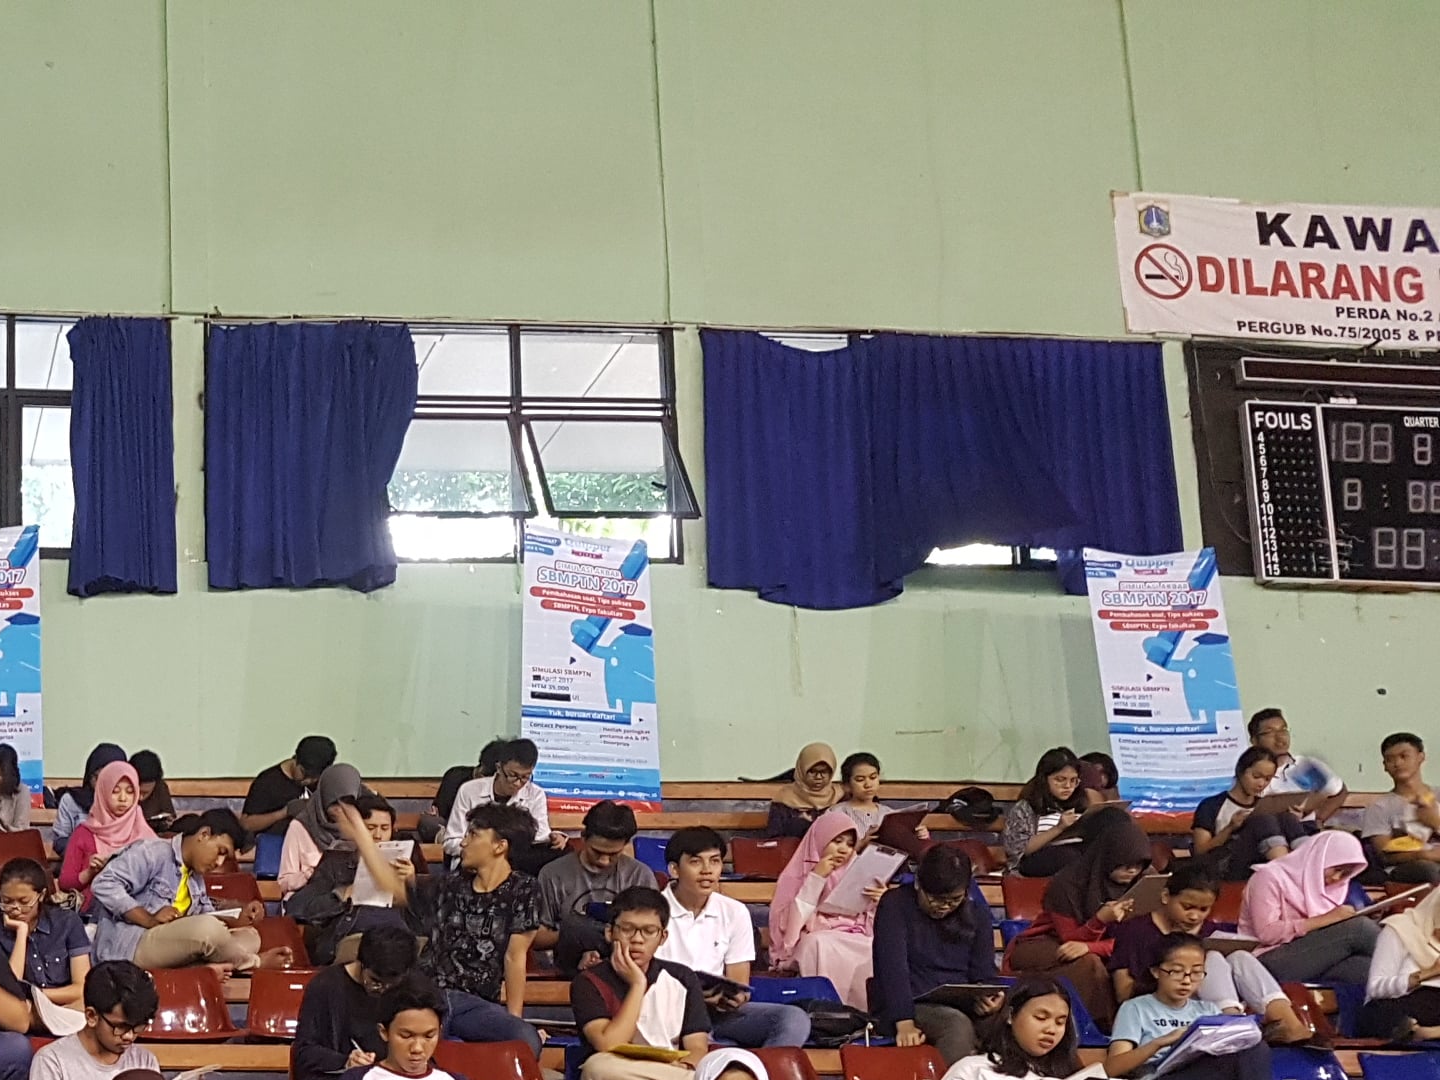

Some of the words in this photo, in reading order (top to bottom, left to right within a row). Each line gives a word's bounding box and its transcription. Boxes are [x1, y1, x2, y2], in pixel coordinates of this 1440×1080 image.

[1255, 211, 1440, 253] KAWA
[1196, 255, 1424, 304] DILARANG
[1335, 306, 1391, 320] PERDA
[1396, 309, 1433, 322] No.2
[1236, 320, 1306, 335] PERGUB
[1408, 330, 1420, 341] &
[1254, 411, 1312, 430] FOULS
[1403, 416, 1440, 428] QUARTER
[1257, 431, 1264, 442] 4
[1258, 443, 1266, 454] 5
[1260, 455, 1267, 466] 6
[1260, 467, 1268, 478] 7
[1262, 479, 1269, 490] 8
[1262, 491, 1270, 502] 9
[1261, 503, 1274, 514] 10
[1262, 516, 1274, 527] 11
[1263, 528, 1276, 539] 12
[1264, 540, 1278, 551] 13
[1265, 552, 1279, 563] 14
[556, 562, 594, 573] SIMULASI
[594, 566, 620, 577] AKBAR
[1266, 564, 1280, 576] 15
[539, 568, 600, 590] SBMPTN
[602, 578, 638, 595] 2017
[1104, 592, 1168, 604] SBMPTN
[1172, 592, 1206, 604] 2017
[532, 666, 563, 674] SIMULASI
[564, 670, 592, 678] SBMPTN
